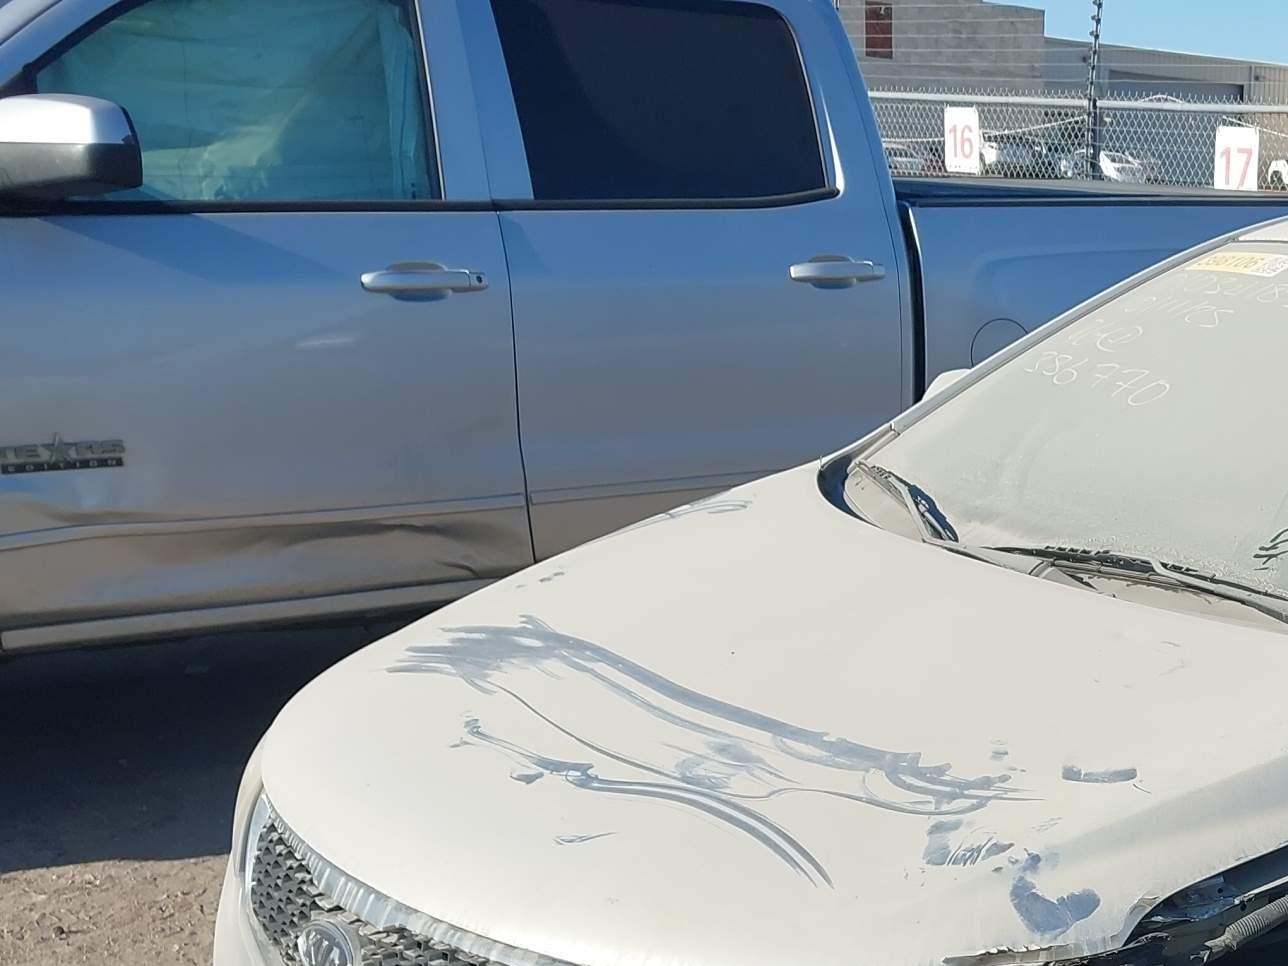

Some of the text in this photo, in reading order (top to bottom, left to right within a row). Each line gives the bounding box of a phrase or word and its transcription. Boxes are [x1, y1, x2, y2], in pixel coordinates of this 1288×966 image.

[948, 124, 974, 159] 16
[1219, 146, 1253, 188] 17
[7, 458, 118, 472] EDITION
